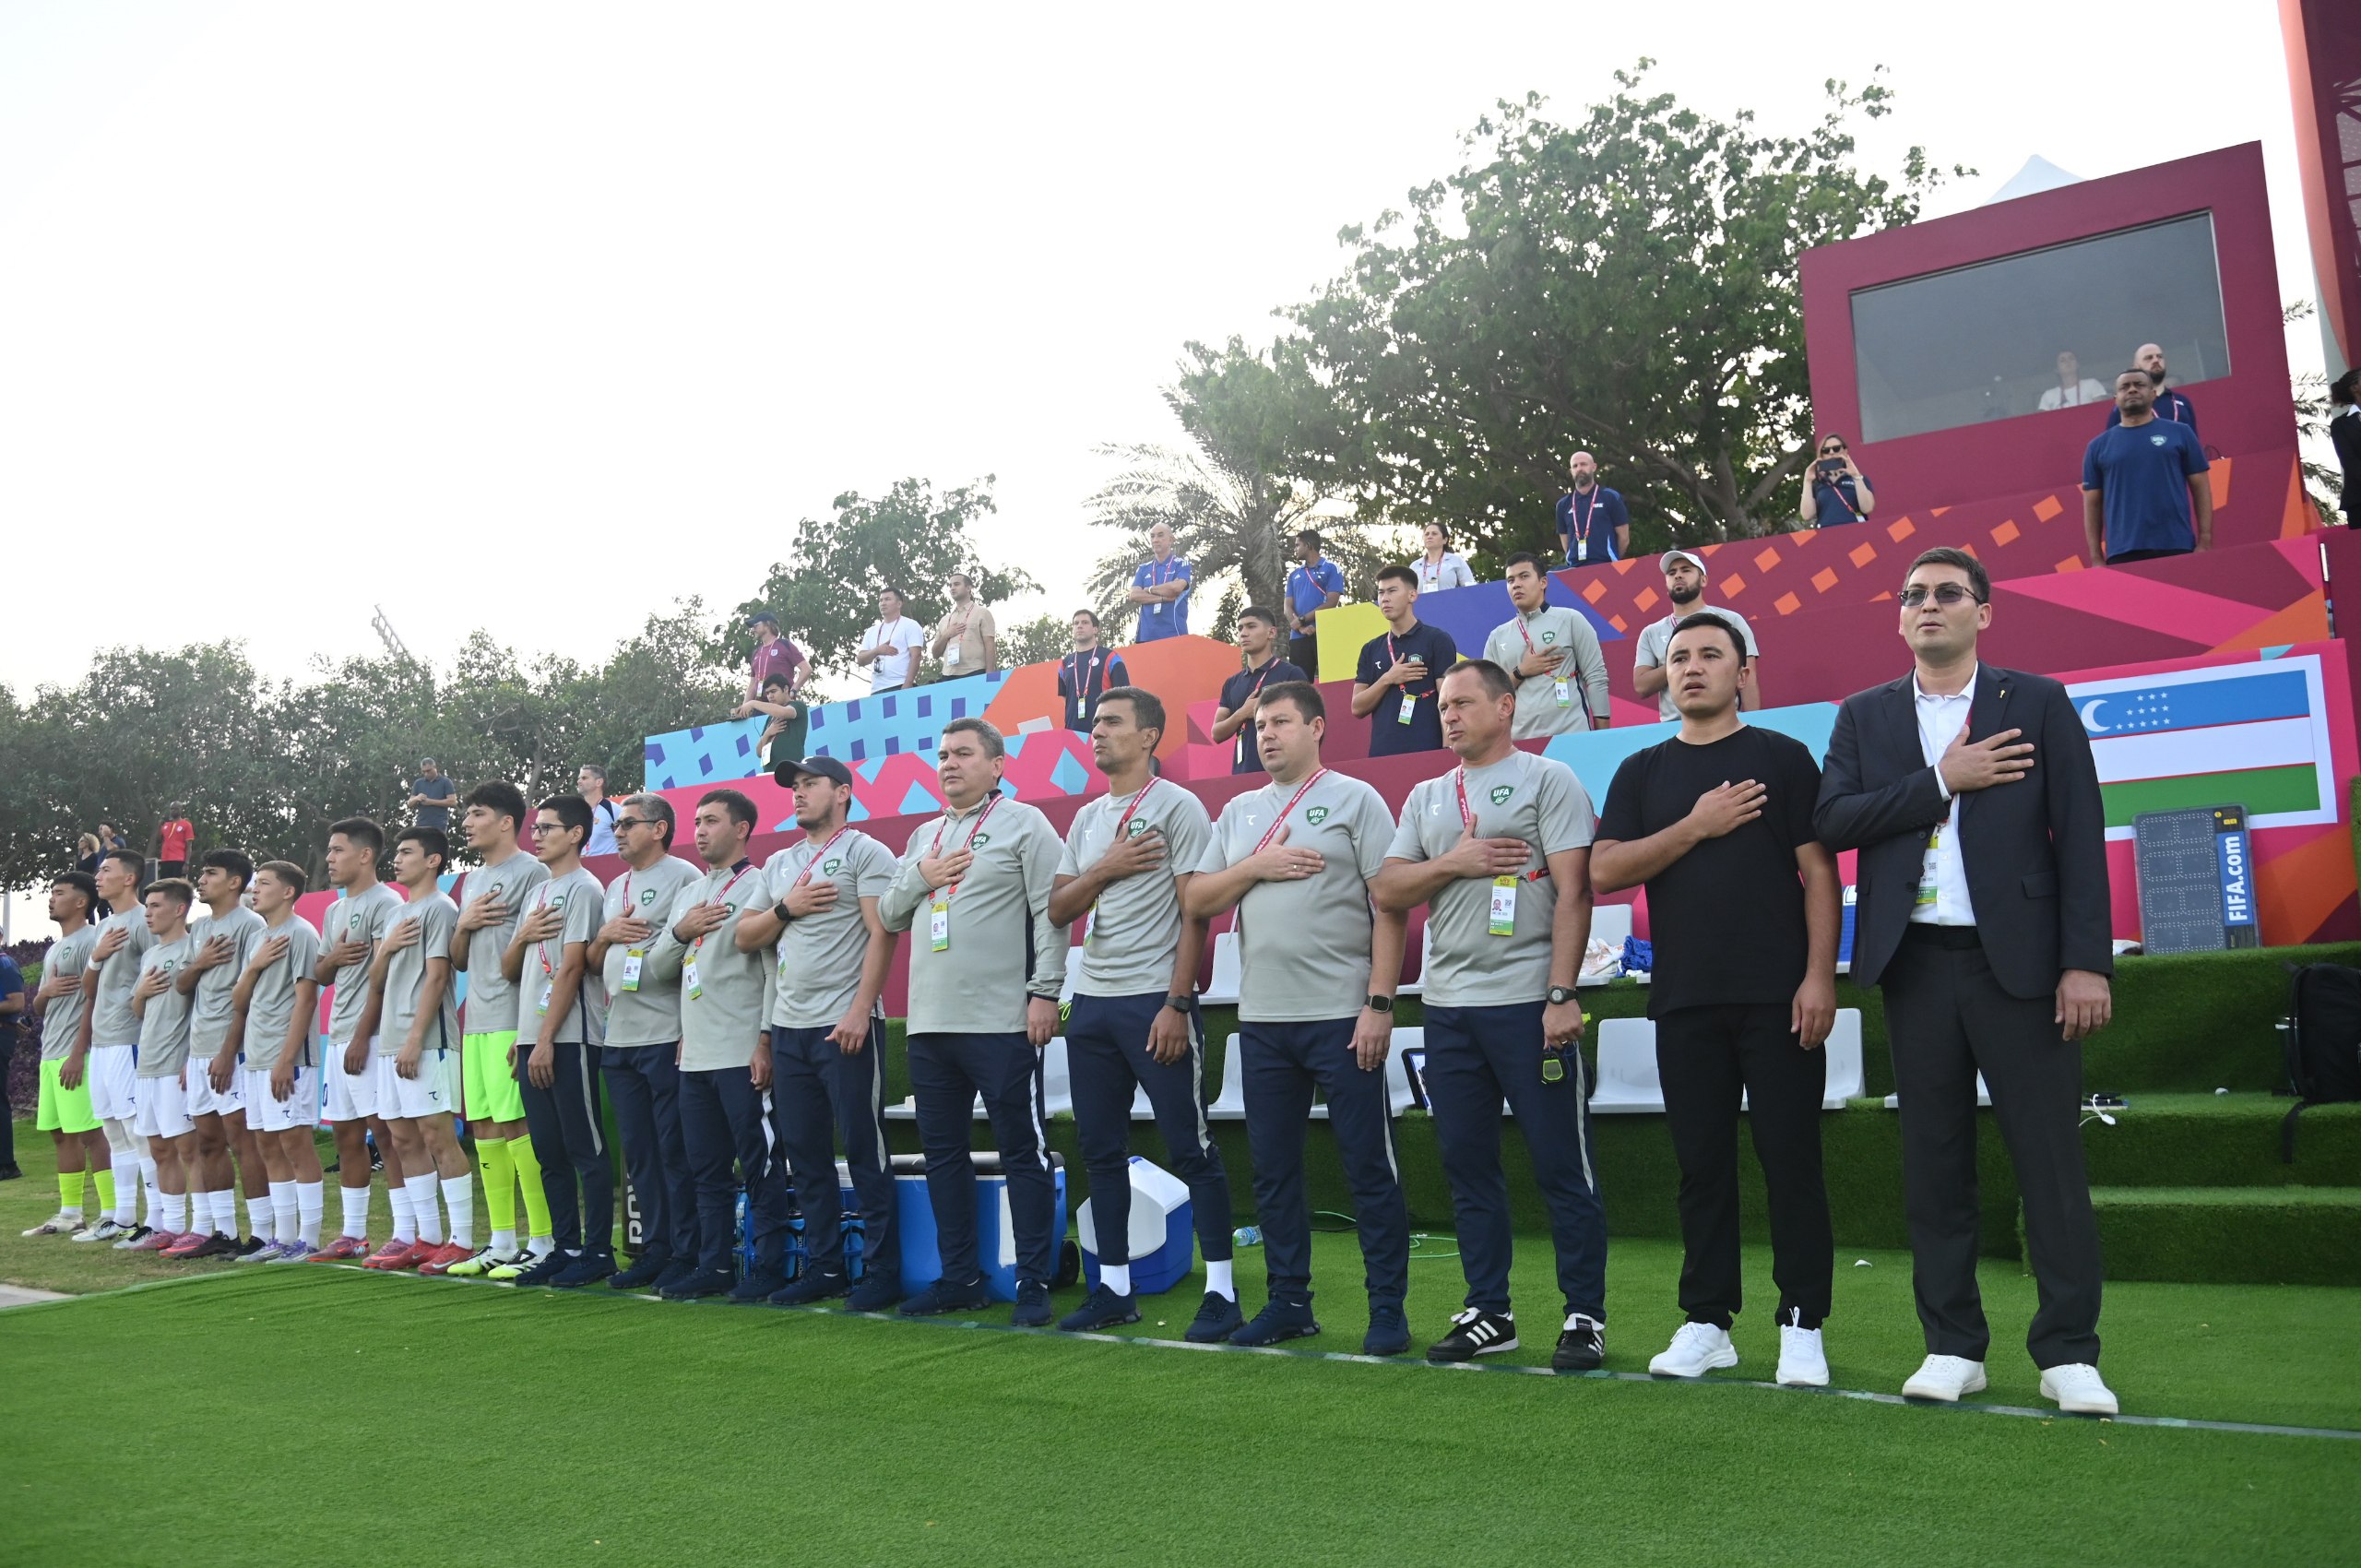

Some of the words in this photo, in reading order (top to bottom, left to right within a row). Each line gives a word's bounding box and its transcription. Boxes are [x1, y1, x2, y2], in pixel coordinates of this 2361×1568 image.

[1493, 788, 1510, 797] UFA
[1309, 809, 1324, 817] UFA
[1130, 821, 1144, 829] UFA
[2225, 836, 2248, 921] FIFA.com
